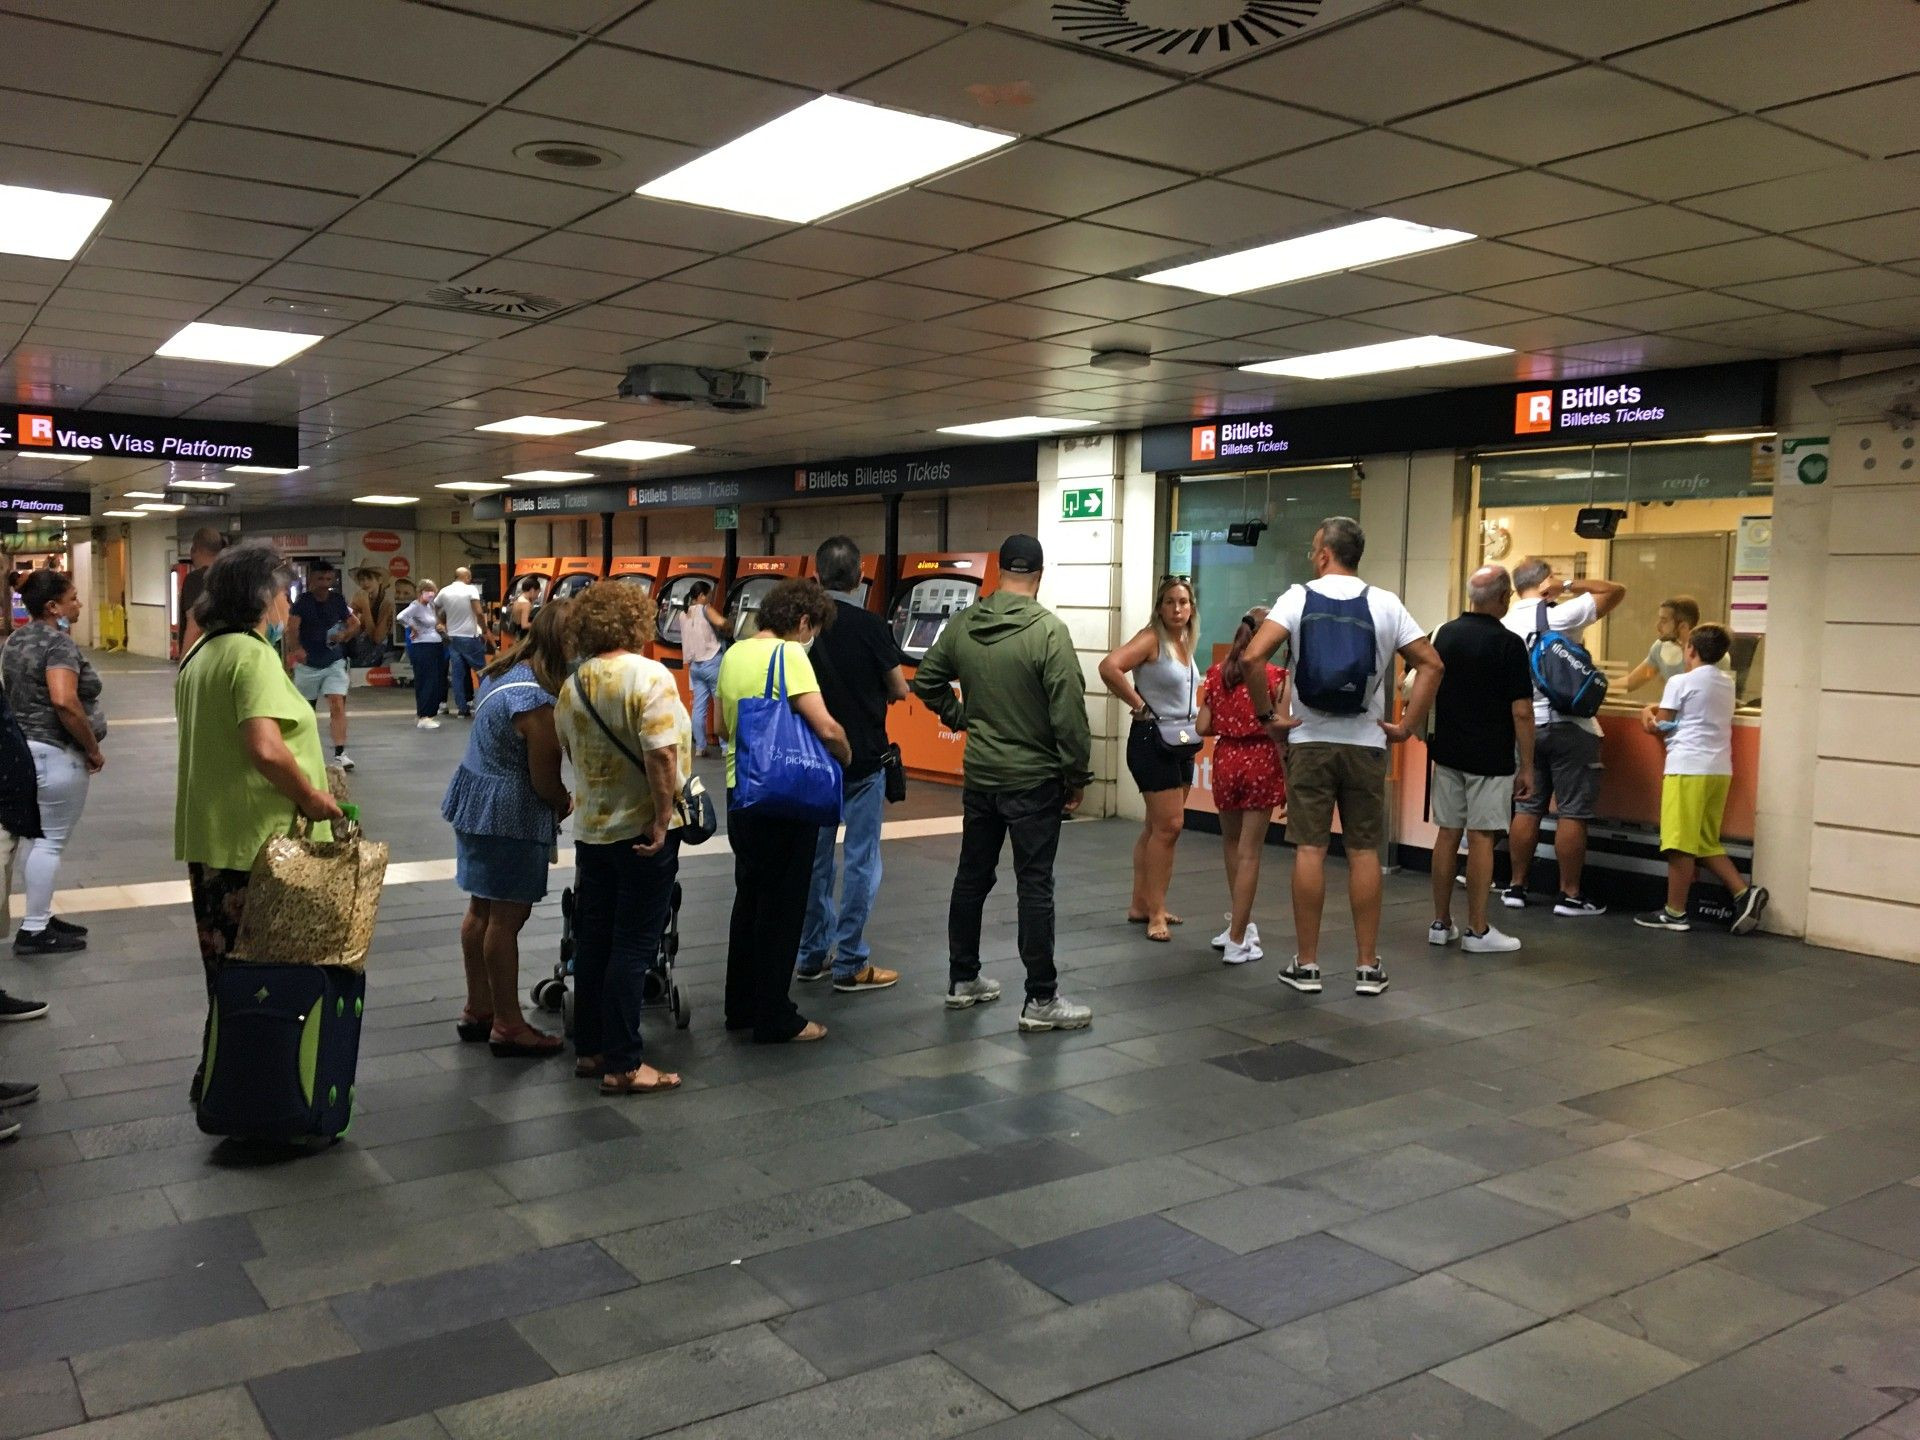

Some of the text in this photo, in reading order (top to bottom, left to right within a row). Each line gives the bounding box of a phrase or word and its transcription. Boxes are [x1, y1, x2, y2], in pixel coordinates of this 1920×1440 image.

[1561, 384, 1641, 410] Bitllets
[1560, 406, 1665, 428] Billetes Tickets
[31, 418, 253, 459] R Vies Vías Platforms
[1221, 422, 1274, 441] Bitllets
[1221, 440, 1289, 456] Billetes Tickets
[808, 470, 849, 489] Bitllets
[855, 467, 898, 486] Billetes
[906, 461, 951, 482] Tickets
[1662, 473, 1711, 493] renfe
[707, 481, 740, 498] Tickets
[11, 500, 64, 511] Platforms
[1699, 906, 1732, 918] renfe
